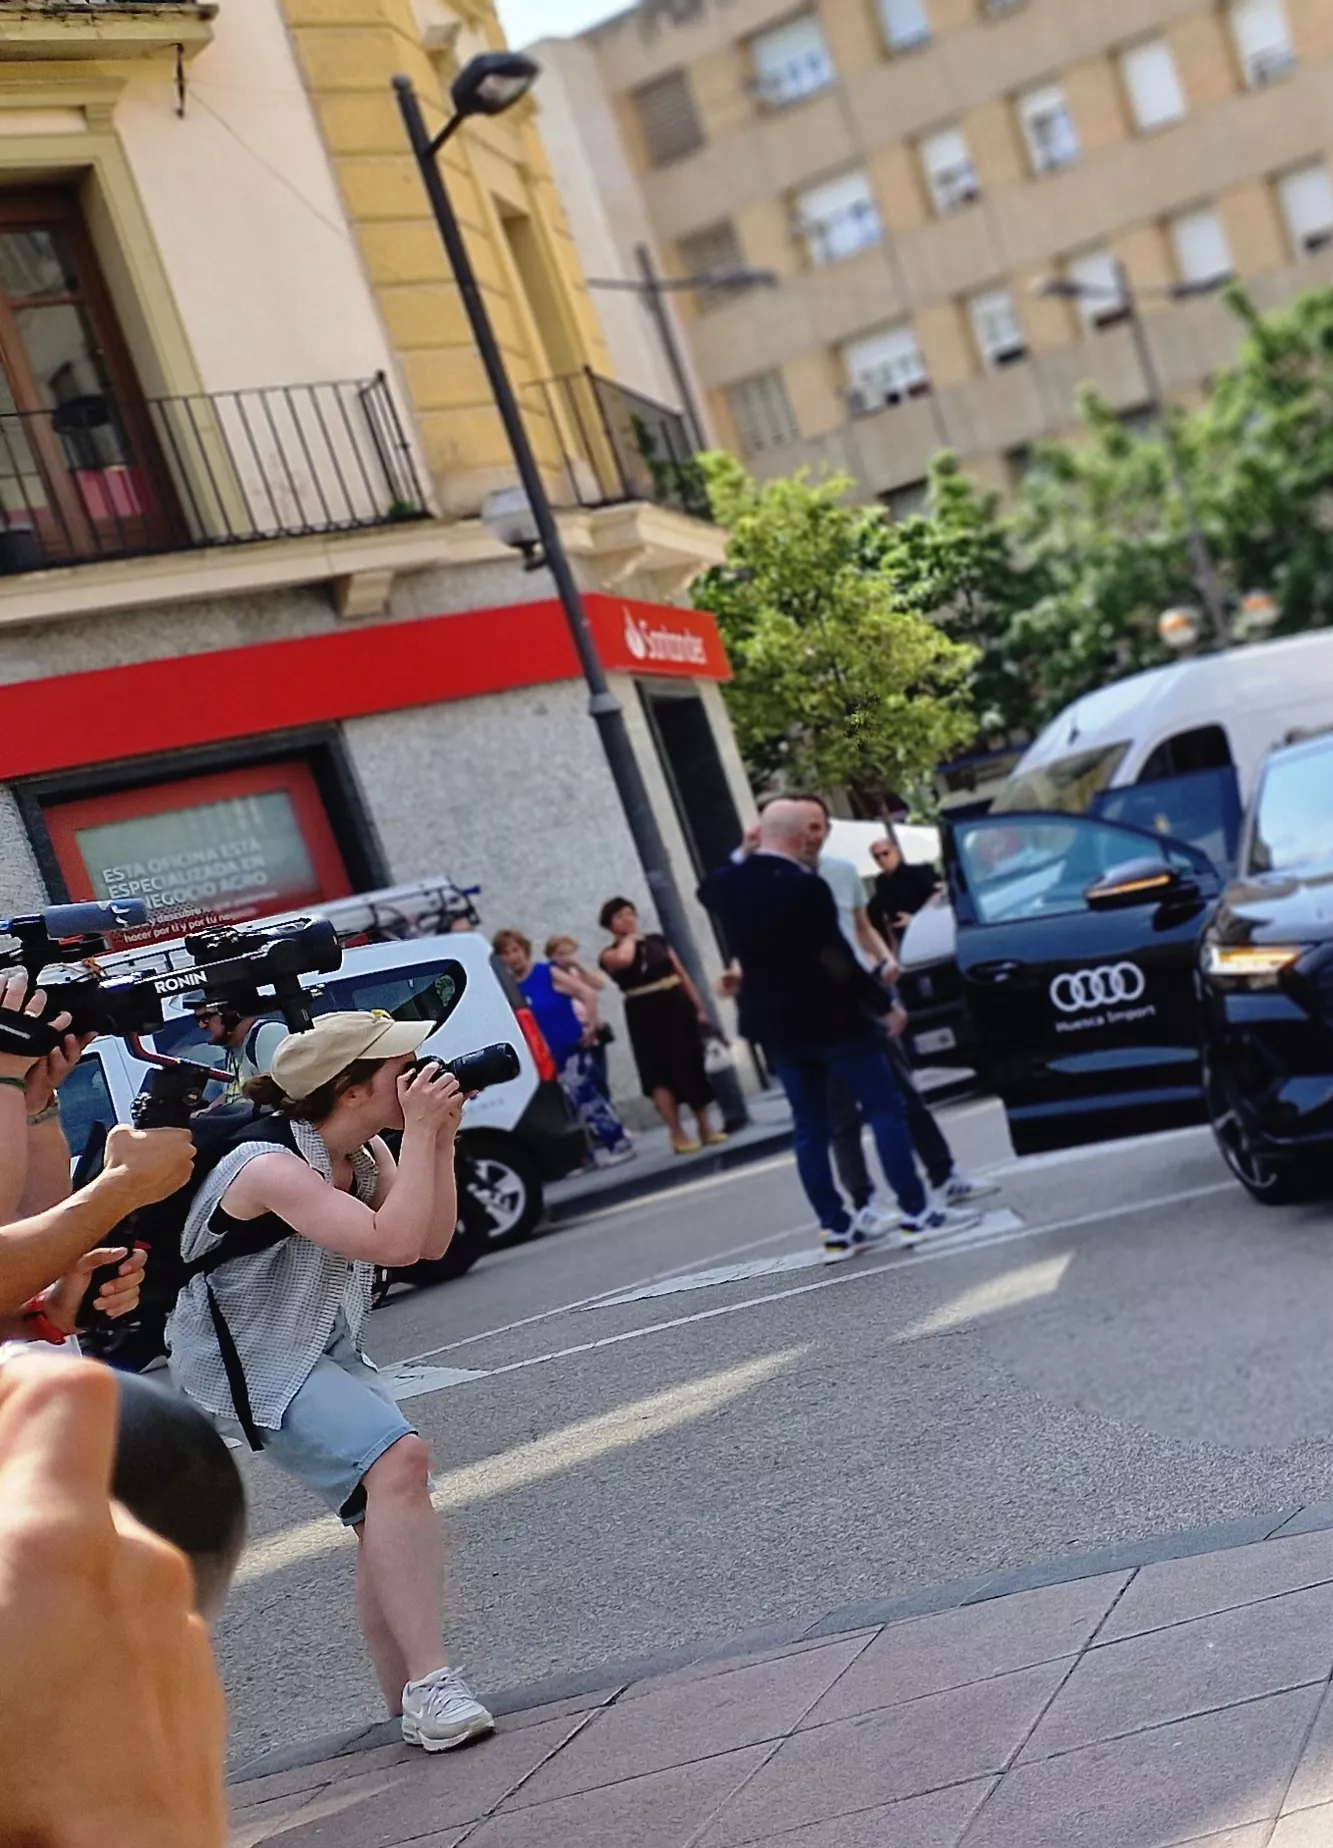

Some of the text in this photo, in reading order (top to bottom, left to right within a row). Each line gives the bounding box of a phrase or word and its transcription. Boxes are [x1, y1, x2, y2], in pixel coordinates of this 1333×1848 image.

[102, 862, 149, 884] ESTA
[147, 846, 219, 874] OFICINA
[107, 853, 267, 899] ESPECIALIZADA EN
[219, 870, 268, 892] AGRO
[124, 930, 152, 943] hacer
[153, 926, 171, 938] por
[187, 918, 205, 930] por
[154, 970, 208, 994] RONIN
[1055, 1004, 1156, 1034] Huesca Import
